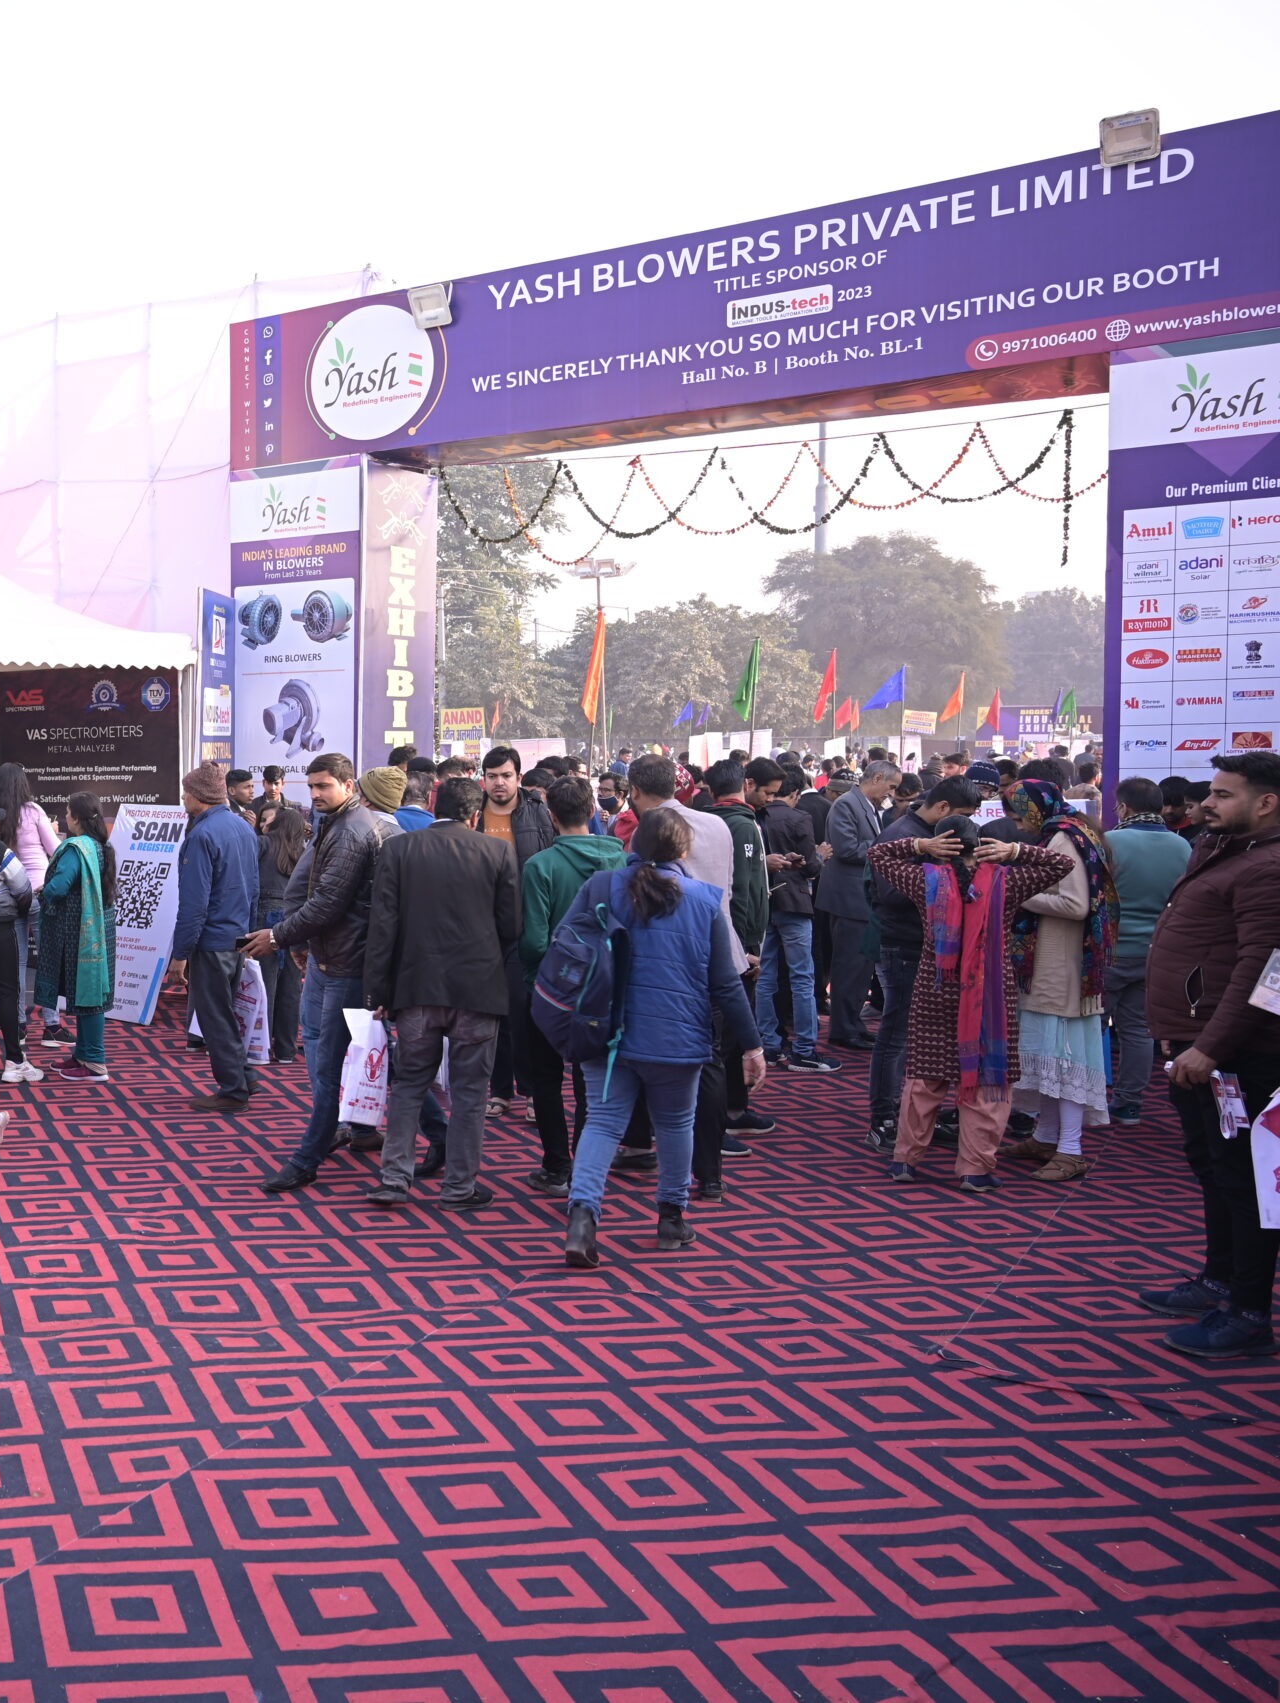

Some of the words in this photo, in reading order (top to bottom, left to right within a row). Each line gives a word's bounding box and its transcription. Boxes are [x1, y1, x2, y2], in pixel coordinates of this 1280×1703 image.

[487, 268, 582, 311] YASH
[593, 229, 781, 293] BLOWERS
[794, 189, 977, 256] PRIVATE
[990, 147, 1196, 219] LIMITED
[713, 273, 762, 294] TITLE
[765, 257, 858, 286] SPONSOR
[861, 249, 889, 267] OF
[836, 285, 873, 303] 2023
[756, 314, 773, 323] TOOLS
[779, 309, 813, 318] AUTOMATION
[471, 374, 502, 394] WE
[505, 357, 613, 389] SINCERELY
[616, 345, 693, 373] THANK
[694, 337, 744, 360] YOU
[749, 332, 781, 351] SO
[787, 318, 859, 346] MUCH
[866, 308, 917, 334] FOR
[920, 288, 1036, 325] VISITING
[1042, 276, 1105, 304] OUR
[1113, 257, 1220, 295] BOOTH
[1001, 328, 1098, 355] 9971006400
[242, 328, 251, 390] CONNECT
[681, 367, 717, 386] Hall
[721, 362, 749, 380] No.
[754, 360, 768, 375] B
[785, 349, 839, 371] Booth
[843, 345, 875, 363] No.
[879, 336, 925, 357] BL-1
[324, 352, 399, 409] Yash
[342, 396, 379, 409] Redefining
[380, 391, 423, 404] Engineering
[1169, 377, 1268, 433] Yash
[243, 401, 251, 435] WITH
[1194, 422, 1240, 433] Redefining
[244, 445, 251, 462] US
[1165, 485, 1188, 498] Our
[1191, 480, 1248, 496] Premium
[261, 496, 311, 533] Yash
[1126, 521, 1174, 539] Amul
[1186, 521, 1221, 530] MOTHER
[241, 549, 273, 563] INDIA'S
[274, 545, 314, 561] LEADING
[314, 543, 348, 557] BRAND
[263, 559, 274, 571] IN
[274, 556, 325, 570] BLOWERS
[1136, 561, 1160, 571] adani
[1178, 554, 1224, 571] adani
[264, 570, 280, 580] From
[280, 569, 295, 579] Last
[295, 569, 305, 578] 23
[305, 567, 323, 577] Years
[1133, 569, 1162, 578] wilmar
[1190, 573, 1211, 581] Solar
[1229, 610, 1280, 619] HARIKRUSHNA
[1128, 619, 1169, 632] Raymond
[264, 653, 285, 665] RING
[285, 651, 323, 664] BLOWERS
[1177, 652, 1221, 660] BIKANERVALA
[5, 689, 45, 705] VAS
[1186, 696, 1223, 706] YAMAHA
[5, 704, 46, 713] SPECTROMETERS
[443, 710, 483, 725] ANAND
[26, 728, 48, 741] VAS
[49, 724, 144, 741] SPECTROMETERS
[47, 745, 73, 753] METAL
[75, 743, 116, 753] ANALYZER
[1184, 740, 1213, 750] Bry-Air
[61, 765, 85, 773] Reliable
[94, 765, 121, 774] Epitome
[121, 764, 158, 774] Performing
[92, 774, 134, 783] Spectroscopy
[112, 794, 136, 803] World
[125, 808, 151, 818] VISITOR
[131, 820, 185, 843] SCAN
[129, 843, 136, 851] &
[137, 842, 176, 853] REGISTER
